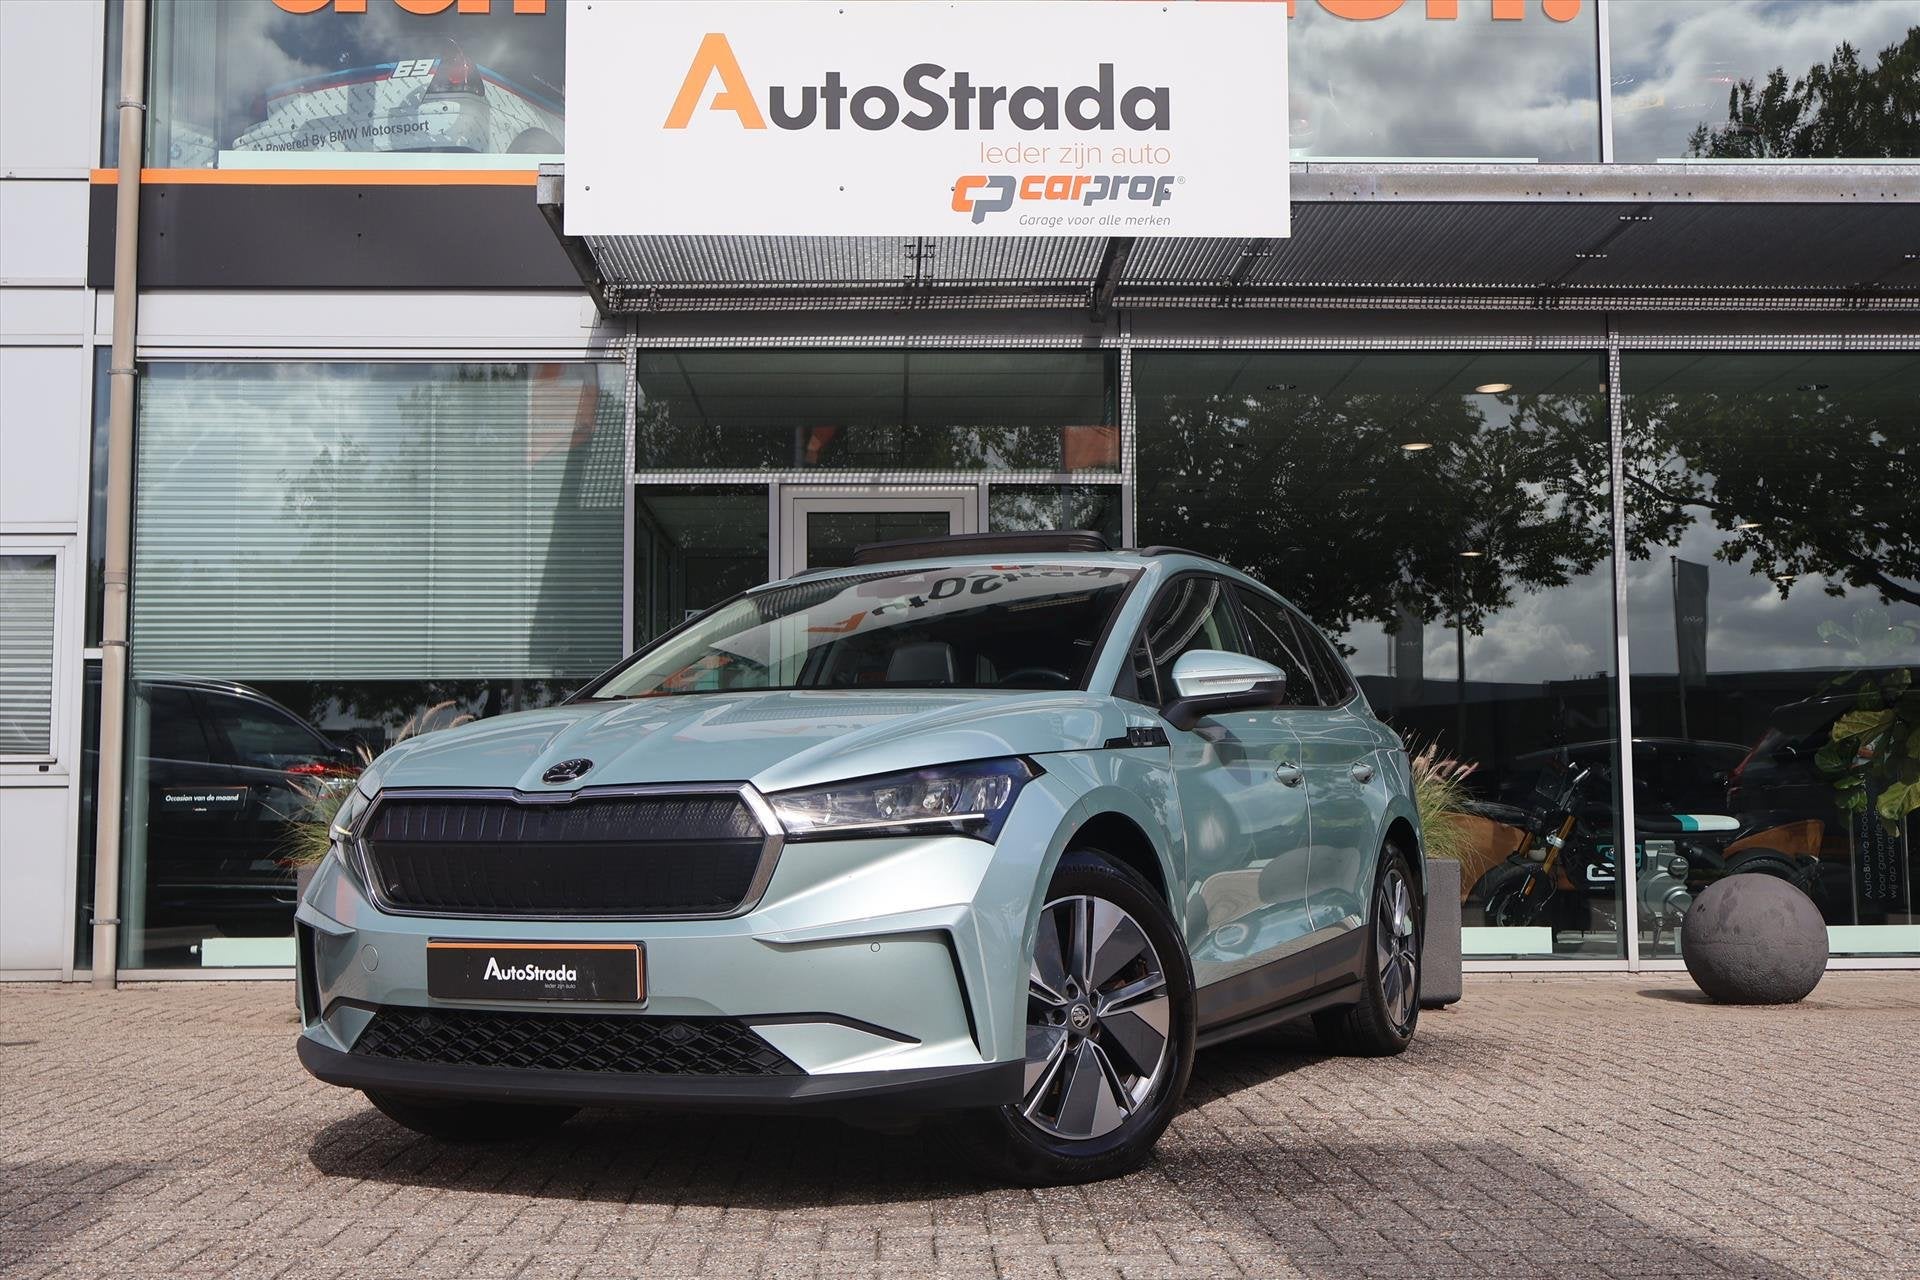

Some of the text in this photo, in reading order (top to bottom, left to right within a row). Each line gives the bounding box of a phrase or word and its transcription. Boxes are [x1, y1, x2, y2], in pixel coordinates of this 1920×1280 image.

[392, 58, 435, 78] 69
[662, 32, 1171, 132] AutoStrada
[266, 119, 430, 151] Powered By BMW Motorsport
[1059, 142, 1102, 170] zijn
[1111, 145, 1171, 164] auto
[1019, 214, 1171, 228] Garage voor alle merken
[165, 793, 193, 802] Occasion
[206, 793, 215, 802] de
[216, 793, 240, 802] maand
[483, 956, 577, 981] AutoStrada
